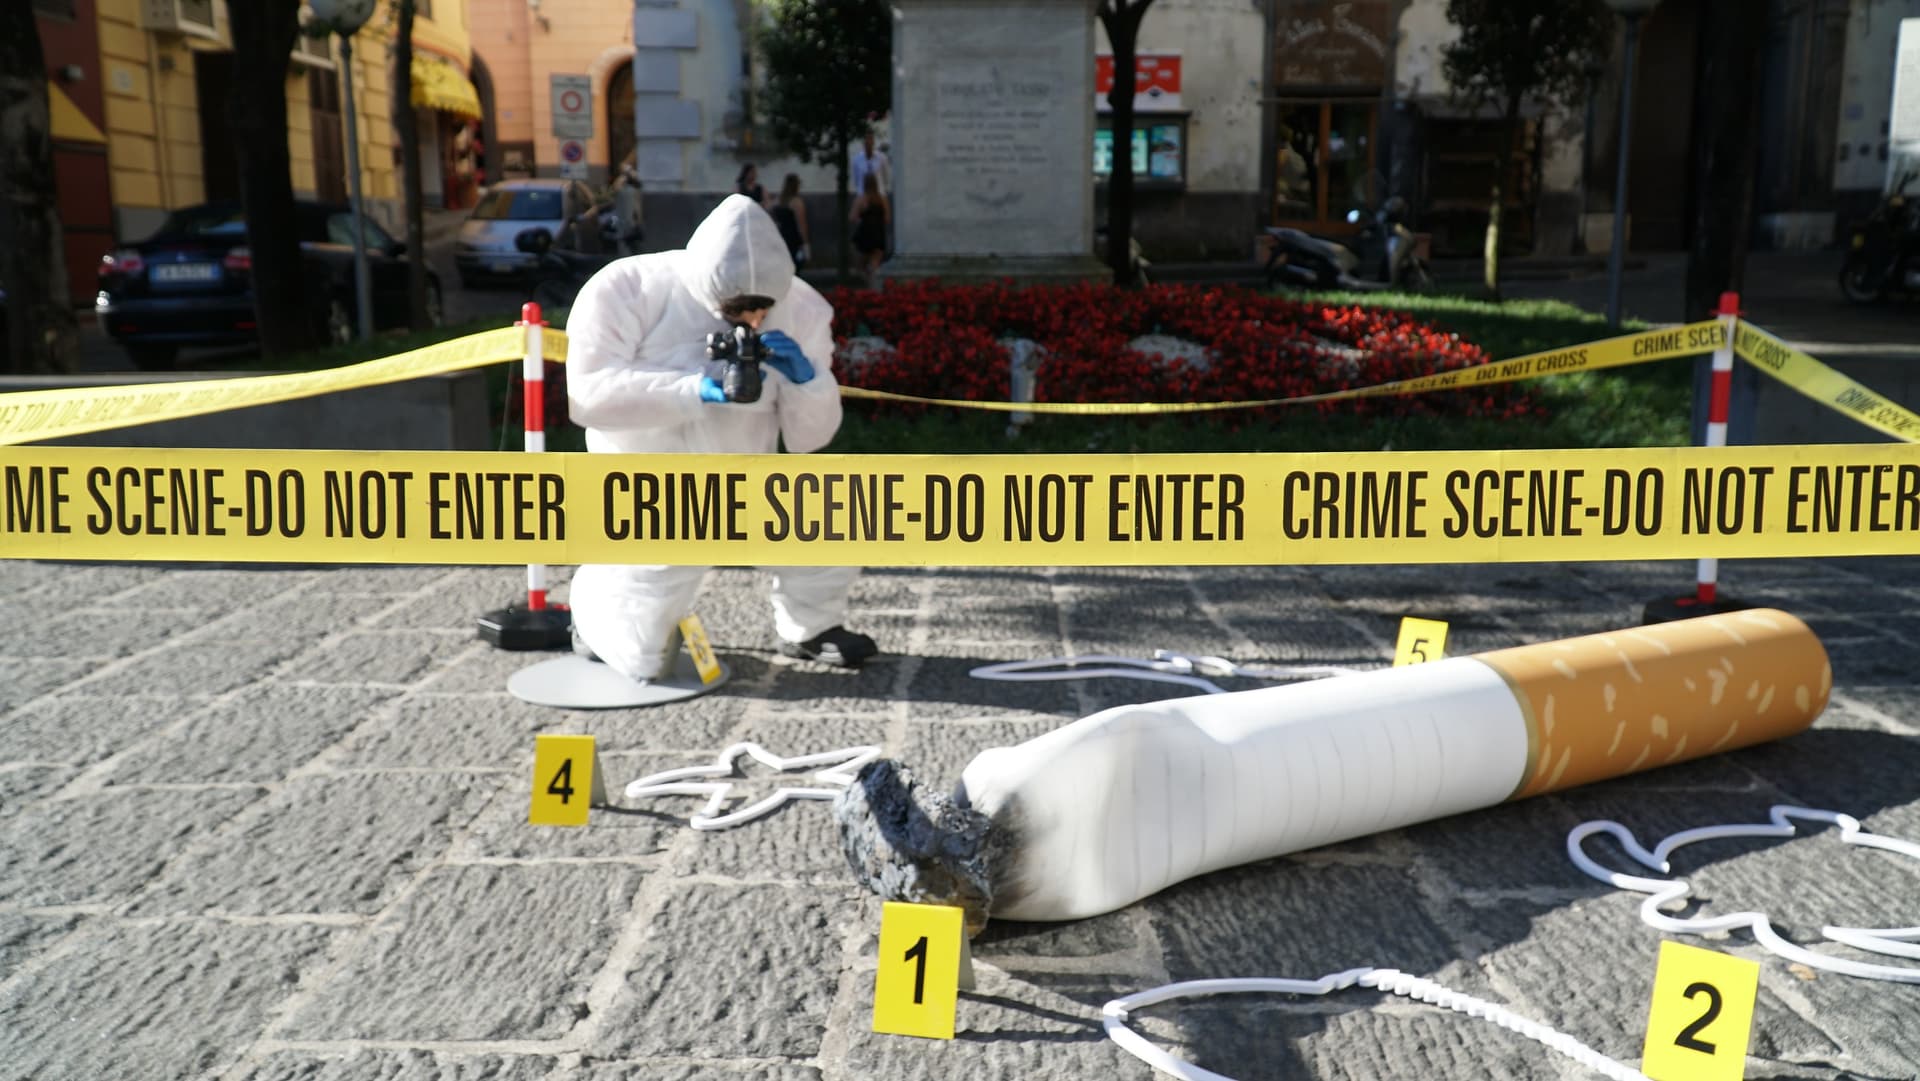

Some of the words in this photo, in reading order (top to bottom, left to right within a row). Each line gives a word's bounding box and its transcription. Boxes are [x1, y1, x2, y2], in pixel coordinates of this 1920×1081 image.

[1475, 367, 1496, 382] DO
[1501, 359, 1532, 378] NOT
[1536, 349, 1588, 373] CROSS
[1633, 329, 1683, 356] CRIME
[0, 466, 71, 533] ME
[87, 466, 305, 537] SCENE-DO
[324, 470, 413, 538] NOT
[429, 472, 565, 540] ENTER
[603, 471, 748, 540] CRIME
[764, 473, 985, 541] SCENE-DO
[1004, 474, 1093, 541] NOT
[1108, 473, 1245, 541] ENTER
[1282, 471, 1428, 539] CRIME
[1443, 467, 1664, 538] SCENE-DO
[1681, 466, 1774, 534] NOT
[1786, 464, 1920, 532] ENTER
[1408, 638, 1429, 665] 5
[547, 758, 574, 805] 4
[904, 936, 928, 1005] 1
[1674, 982, 1723, 1055] 2
